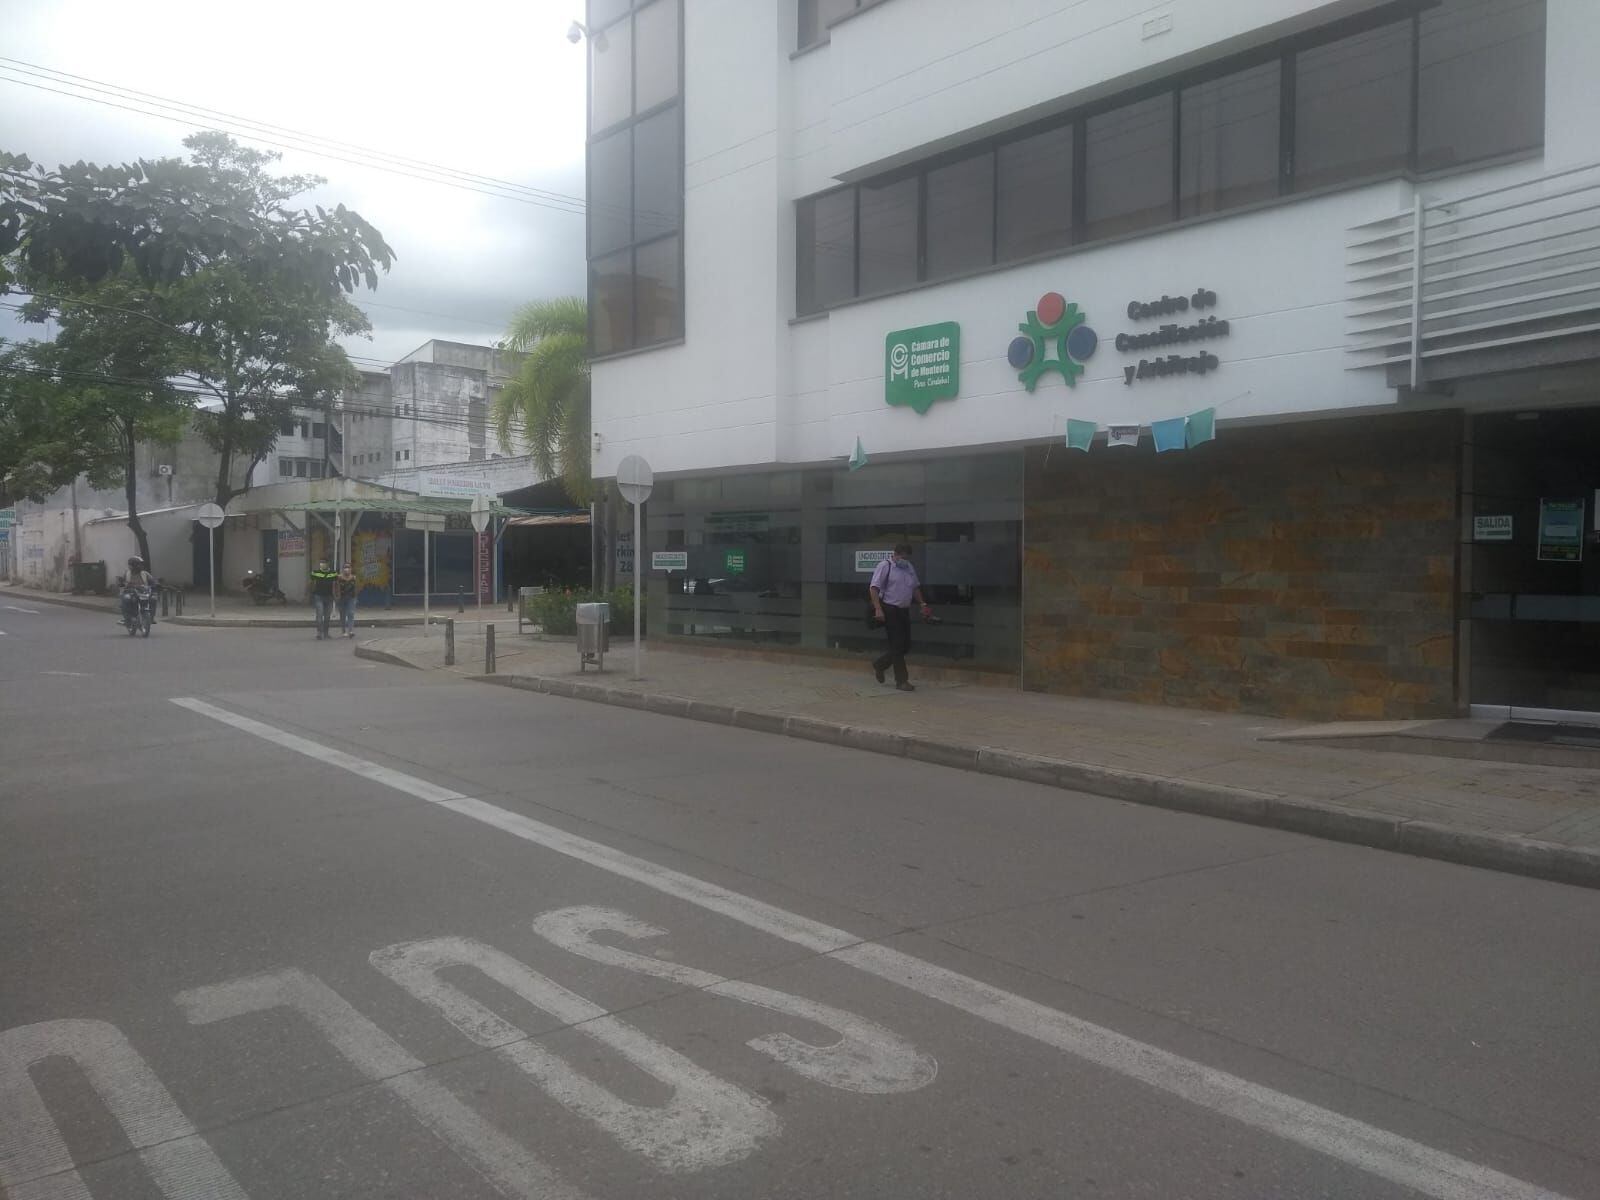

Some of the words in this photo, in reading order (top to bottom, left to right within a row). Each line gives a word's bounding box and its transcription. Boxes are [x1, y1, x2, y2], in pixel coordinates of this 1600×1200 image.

[1127, 295, 1189, 320] Centro
[1191, 287, 1217, 311] de
[1115, 315, 1230, 352] Conciliación
[939, 337, 950, 348] de
[911, 349, 950, 366] Comercio
[1135, 350, 1219, 380] Arbitraje
[911, 368, 920, 378] de
[1476, 517, 1511, 530] SALIDA
